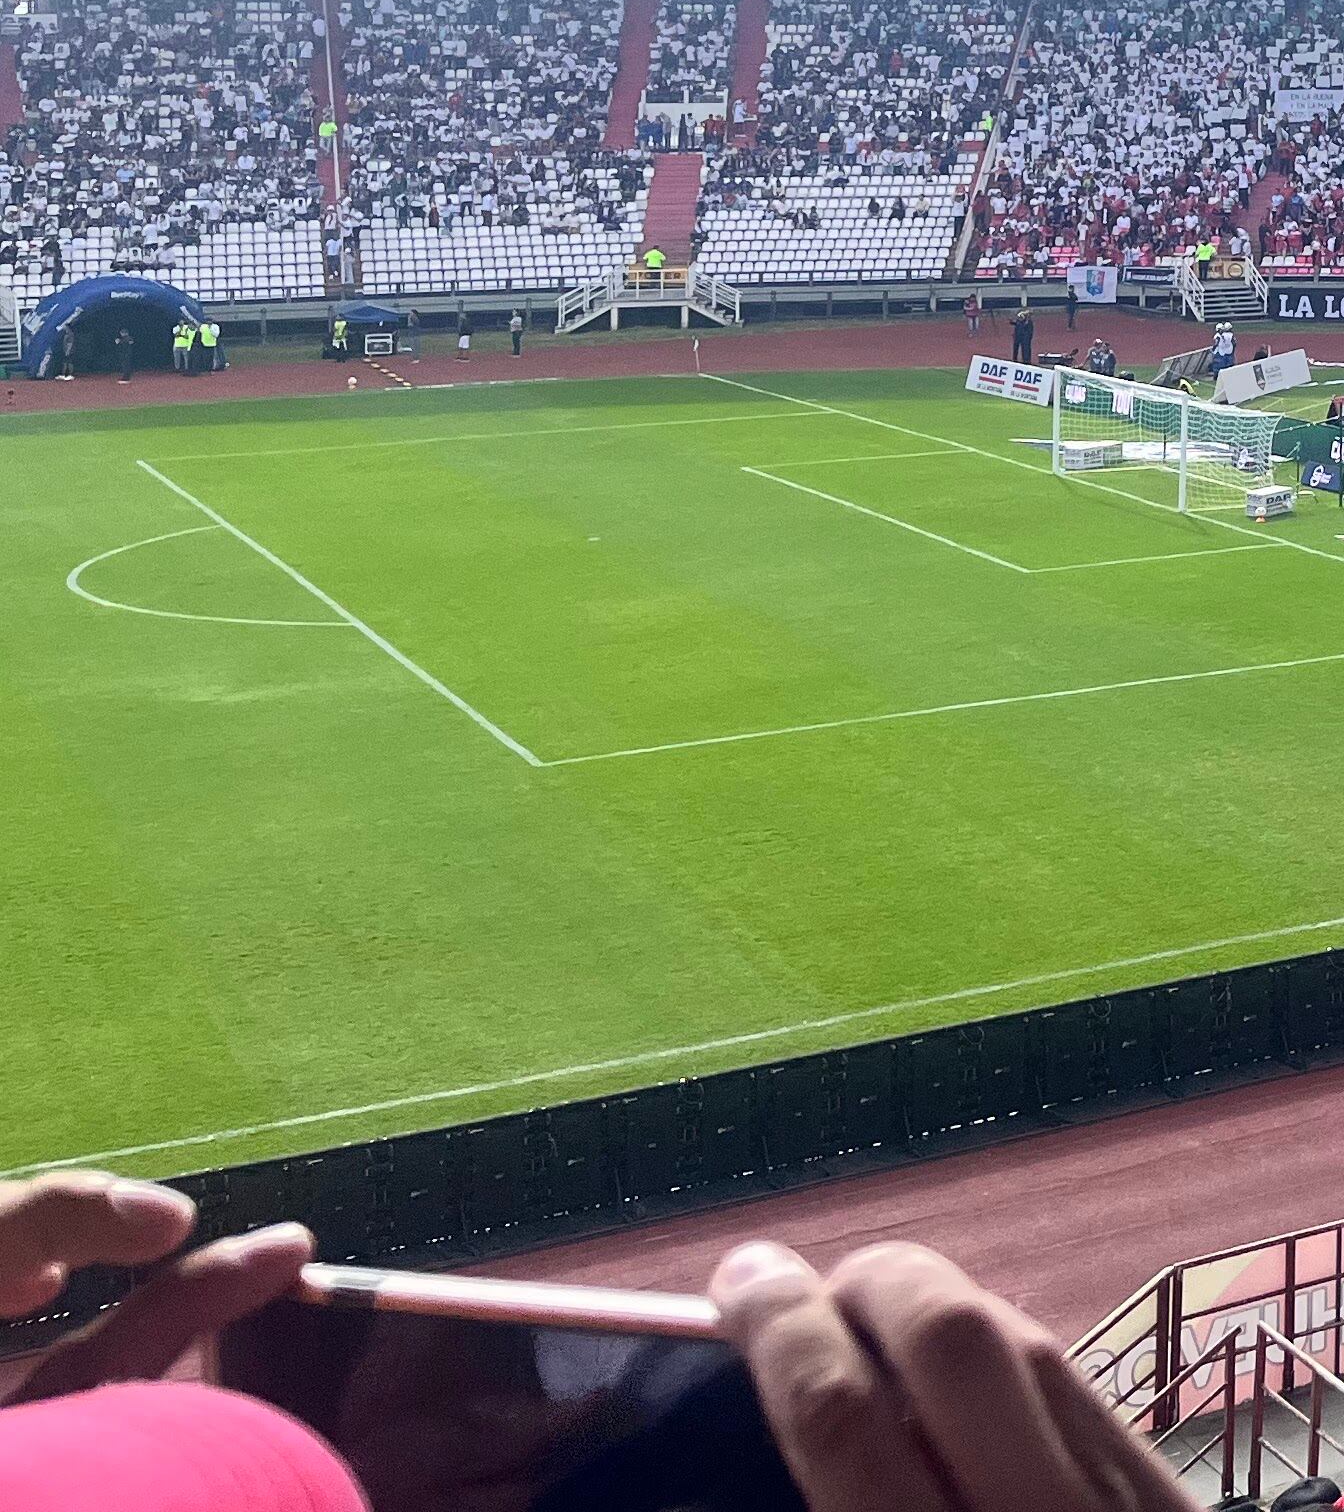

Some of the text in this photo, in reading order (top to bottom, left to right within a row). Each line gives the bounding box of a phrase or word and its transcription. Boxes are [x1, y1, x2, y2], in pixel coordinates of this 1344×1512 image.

[1279, 294, 1315, 318] LA
[980, 362, 1043, 386] DAF DAF
[1266, 494, 1291, 505] DAF
